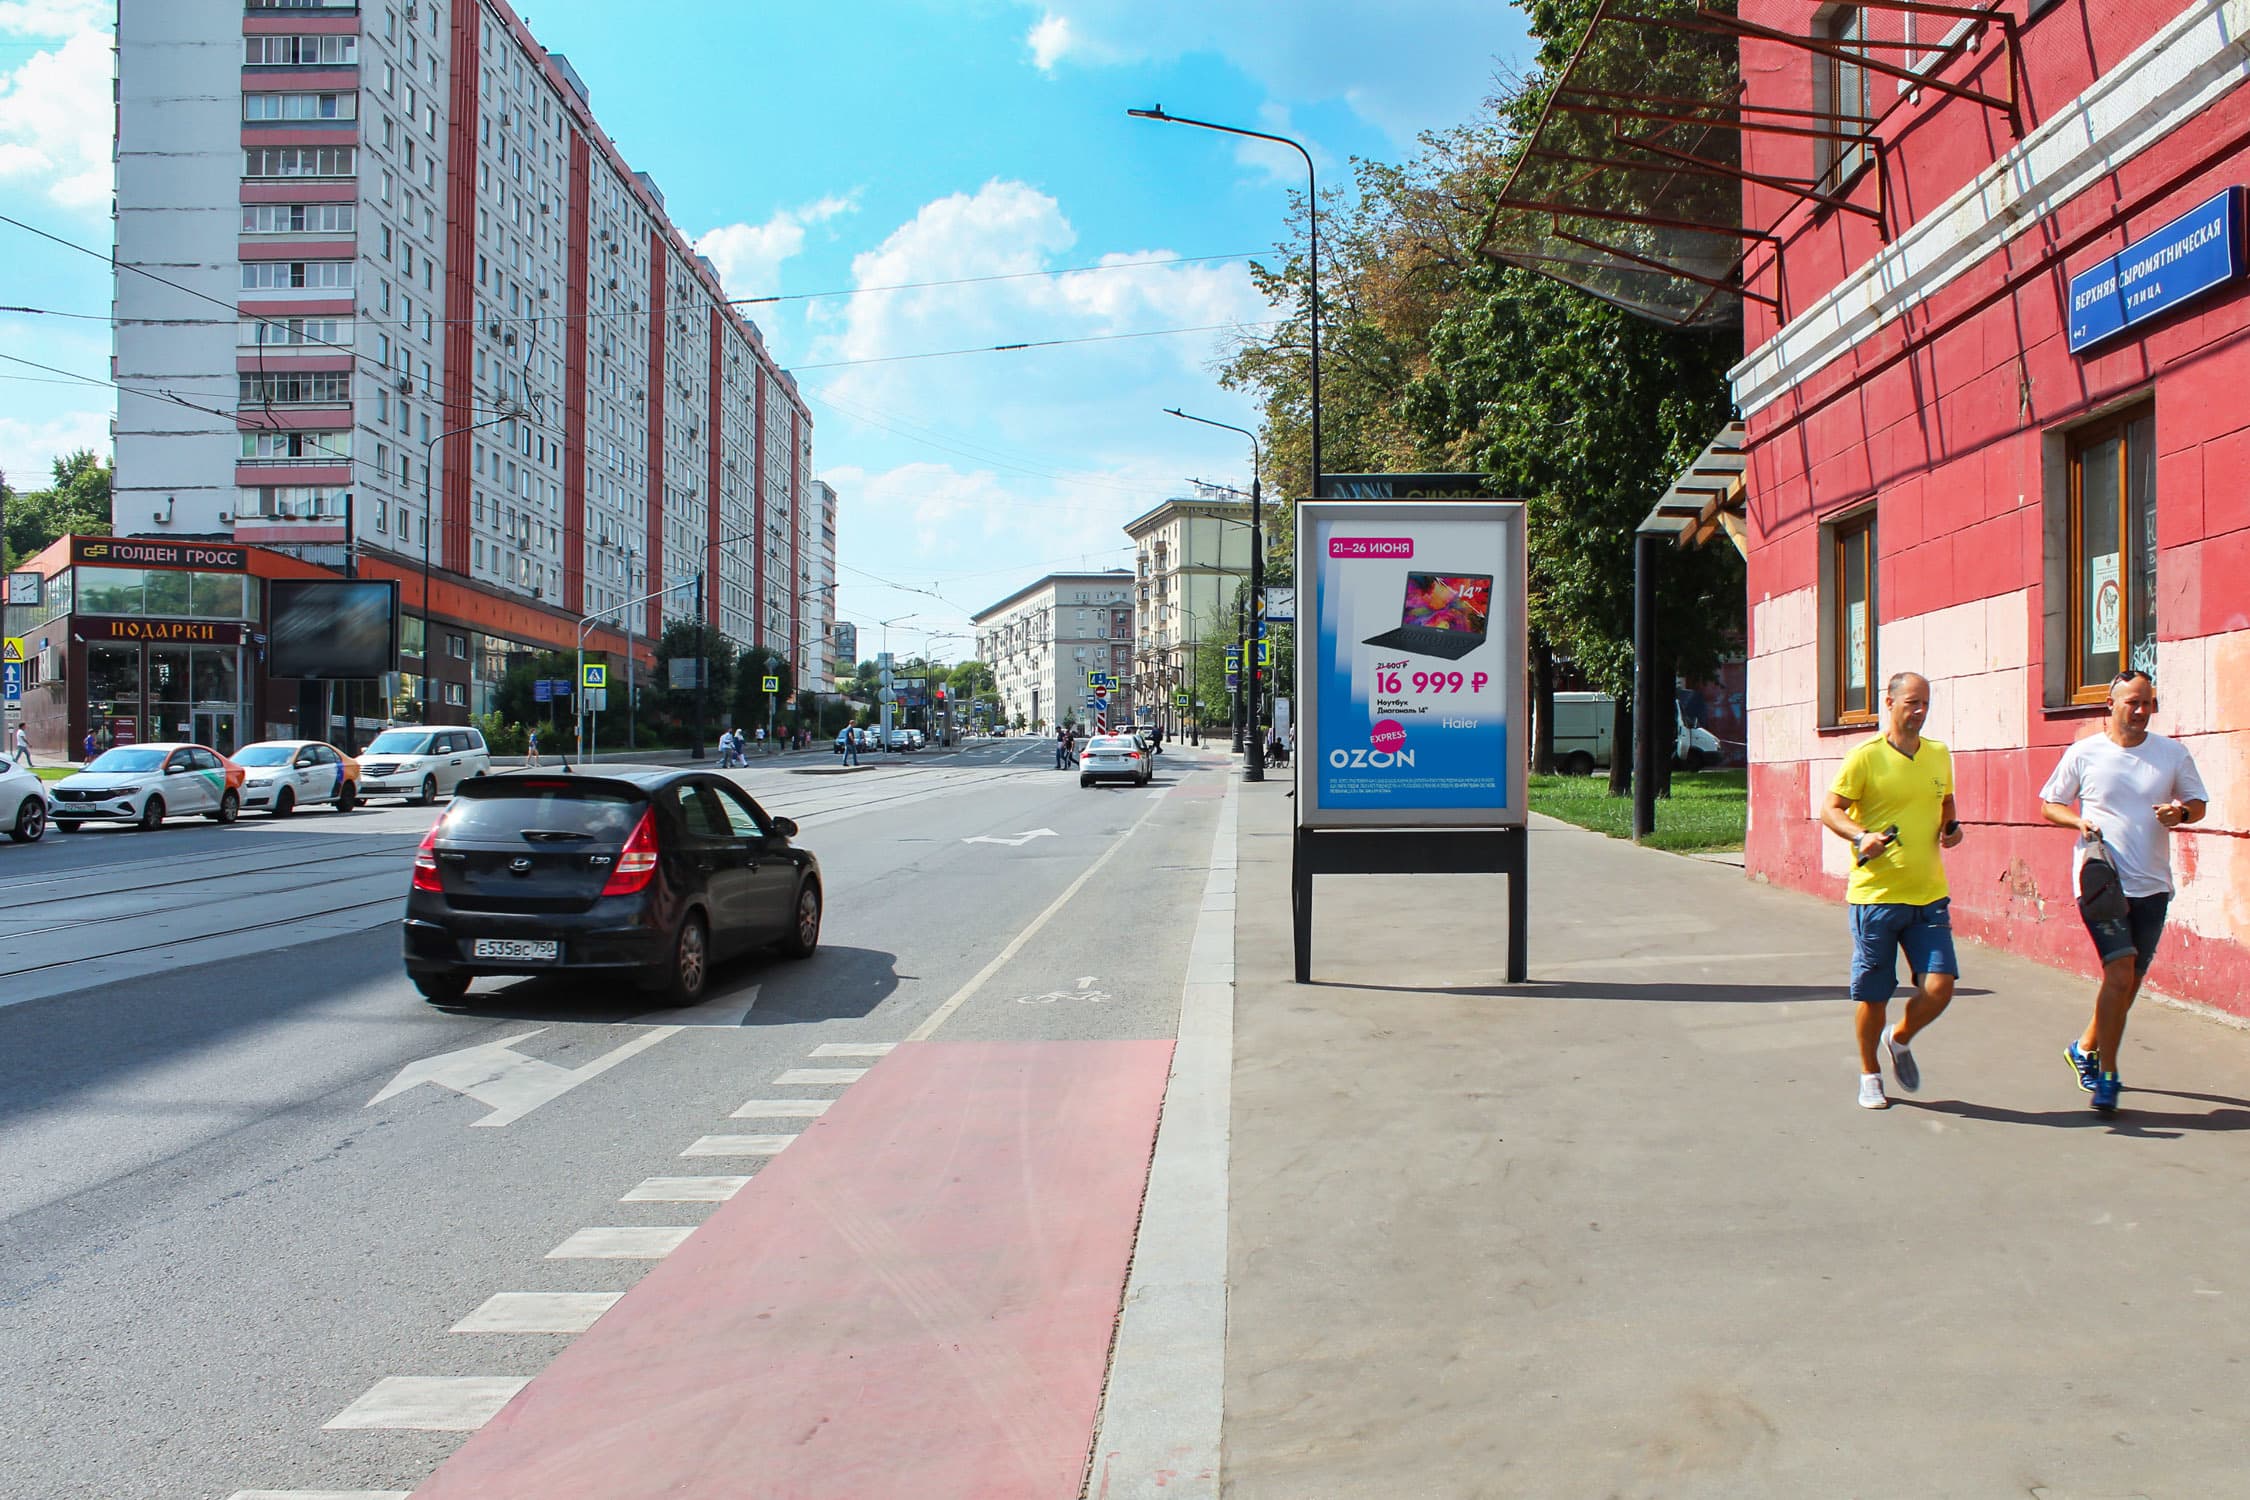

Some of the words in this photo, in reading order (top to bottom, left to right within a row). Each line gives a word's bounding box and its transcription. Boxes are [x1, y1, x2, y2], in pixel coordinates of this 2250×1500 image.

[2075, 276, 2116, 311] ВЕРХНЯЯ
[2118, 217, 2222, 289] СЫРОМЯТНИЧЕСКАЯ
[2126, 282, 2162, 309] УЛИЦА
[112, 545, 178, 562] ГОЛДЕН
[186, 550, 238, 565] ГРОСС
[1369, 543, 1410, 553] ИЮНЯ
[111, 621, 215, 640] ПОДАРКИ
[1376, 671, 1402, 694] 16
[1412, 671, 1464, 694] 999
[1376, 699, 1409, 707] Ноутбук
[1377, 707, 1417, 715] Диагональ
[1442, 718, 1478, 729] Haier
[1369, 730, 1408, 744] EXPRESS
[1329, 748, 1415, 769] OZON
